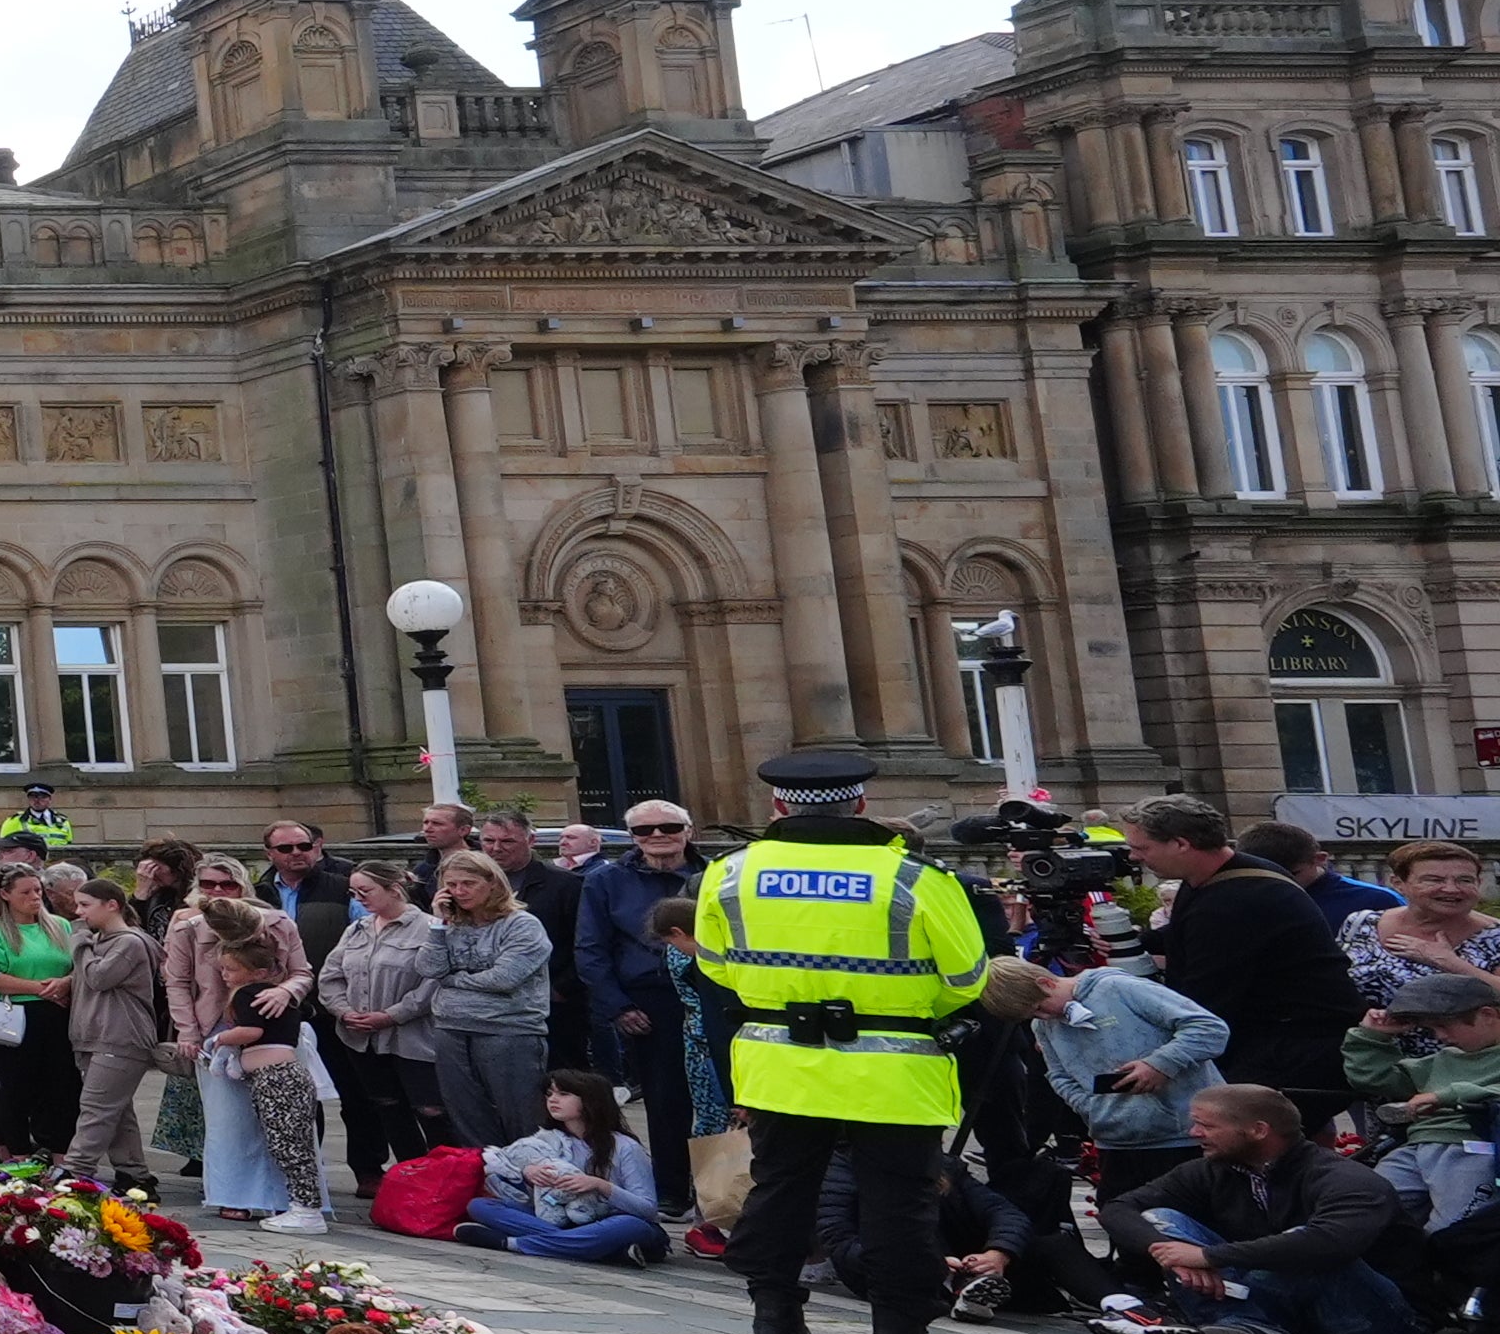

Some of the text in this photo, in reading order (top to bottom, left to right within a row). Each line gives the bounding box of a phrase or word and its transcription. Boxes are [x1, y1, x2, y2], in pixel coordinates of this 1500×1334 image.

[1273, 612, 1357, 651] KINSON
[1269, 657, 1350, 671] LIBRARY
[1336, 816, 1479, 839] SKYLINE
[760, 873, 868, 898] POLICE
